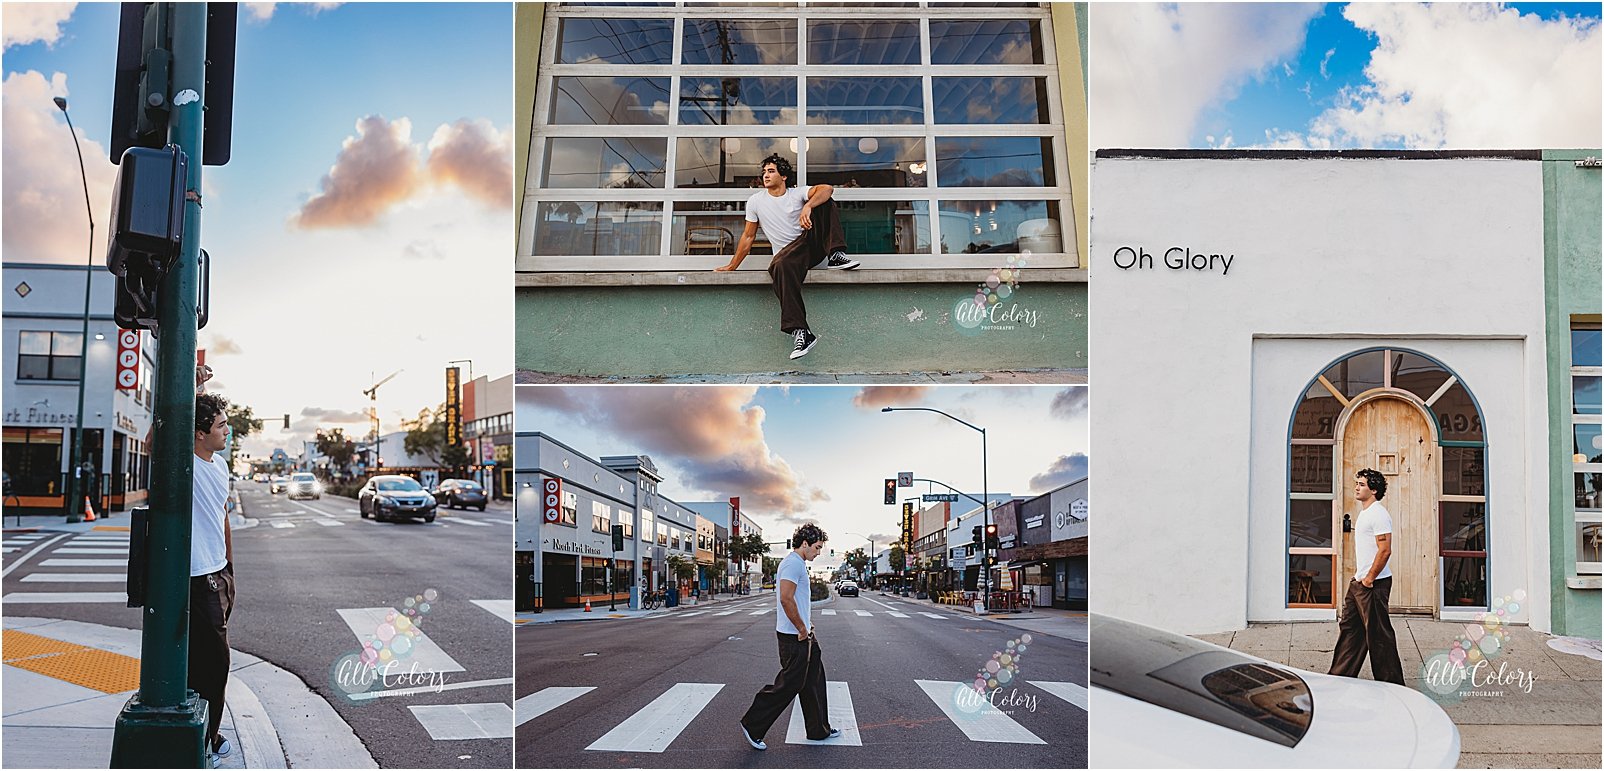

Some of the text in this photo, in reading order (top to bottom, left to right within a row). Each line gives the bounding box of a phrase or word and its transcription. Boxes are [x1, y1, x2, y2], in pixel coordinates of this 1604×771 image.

[1113, 246, 1234, 275] Oh Glory
[26, 407, 75, 423] Fitnes
[552, 538, 571, 552] North
